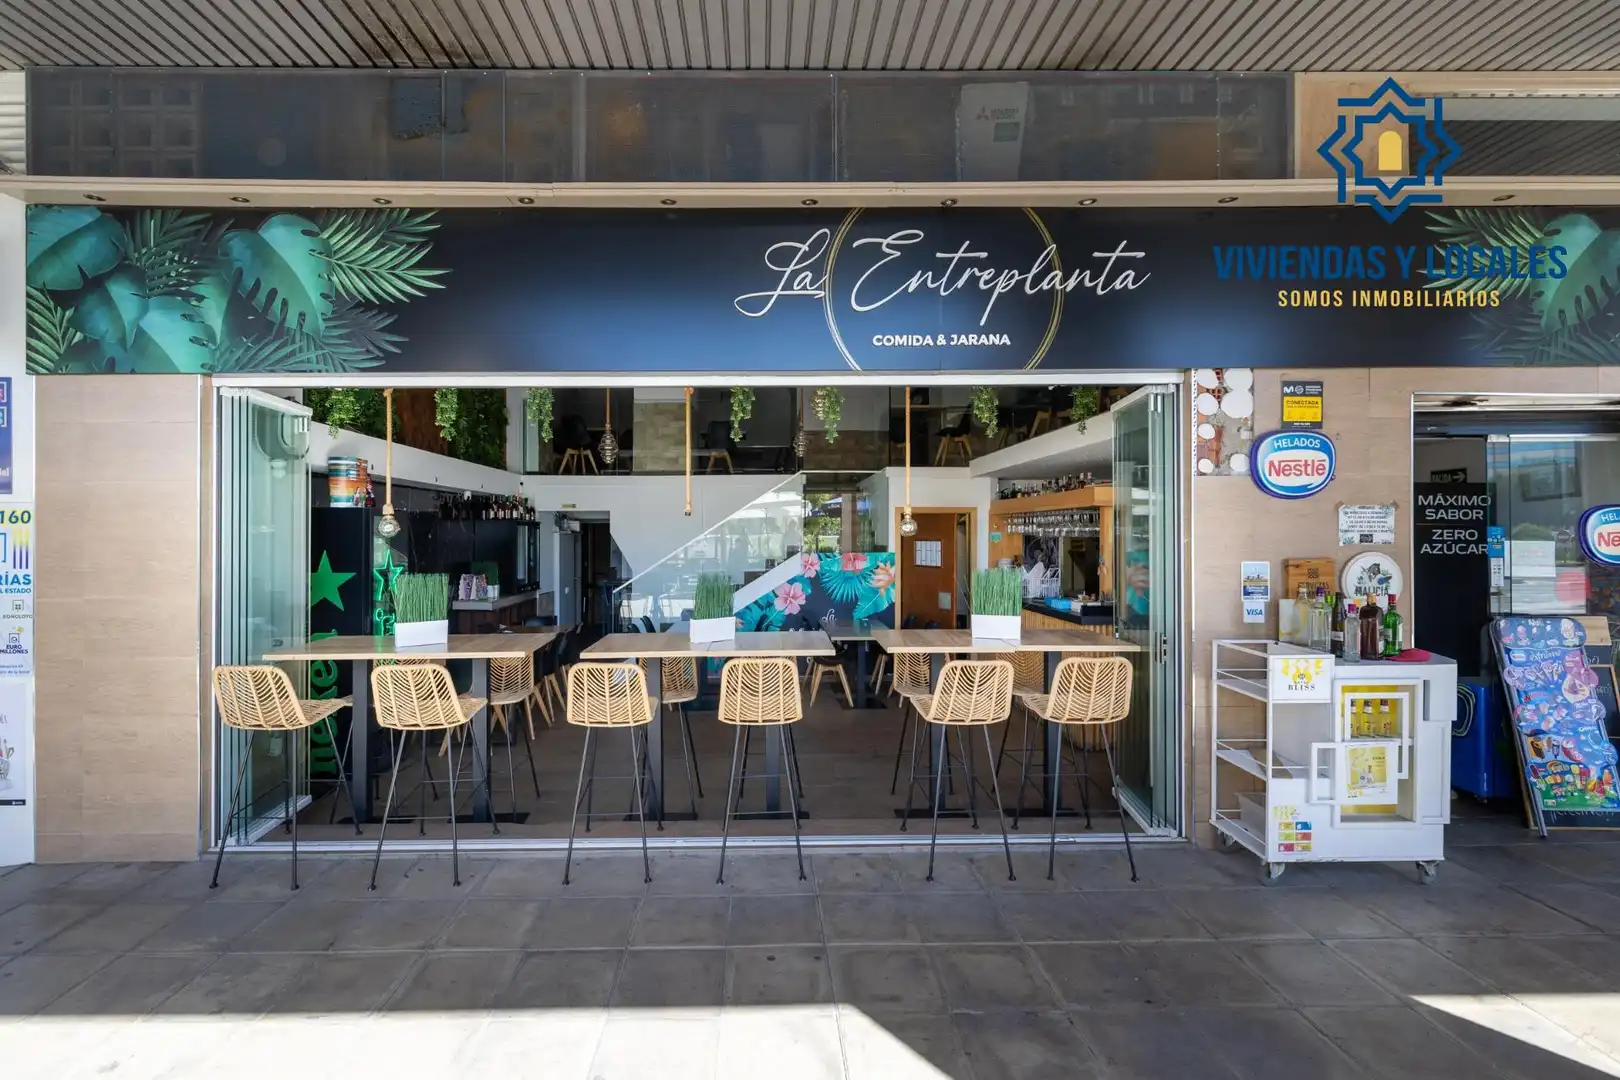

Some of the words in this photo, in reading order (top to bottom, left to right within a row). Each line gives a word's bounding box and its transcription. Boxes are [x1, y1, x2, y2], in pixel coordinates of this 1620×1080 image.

[734, 228, 830, 317] La
[851, 230, 1151, 326] Entreplanta
[872, 334, 934, 347] COMIDA
[936, 334, 947, 346] &
[950, 333, 1011, 346] JARANA
[1274, 437, 1321, 449] HELADOS
[1268, 459, 1326, 477] Nestlé
[1418, 493, 1491, 506] MÁXIMO
[1425, 509, 1484, 520] SABOR
[1601, 513, 1620, 522] HEL
[1432, 529, 1478, 541] ZERO
[1420, 541, 1488, 555] AZÚCAR
[1246, 608, 1263, 616] VISA
